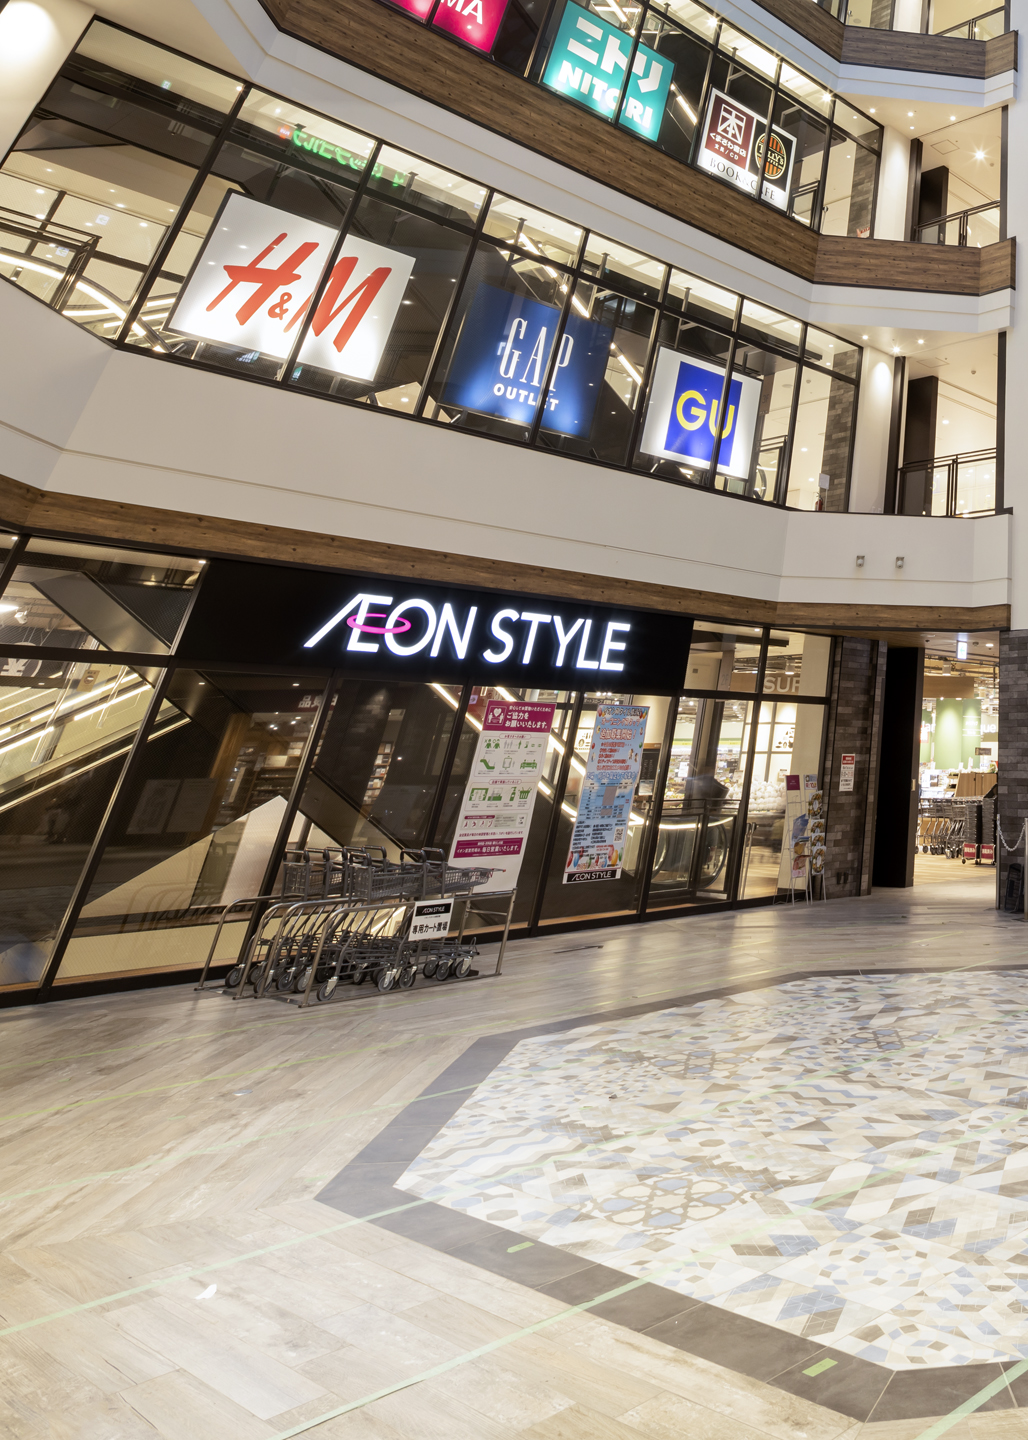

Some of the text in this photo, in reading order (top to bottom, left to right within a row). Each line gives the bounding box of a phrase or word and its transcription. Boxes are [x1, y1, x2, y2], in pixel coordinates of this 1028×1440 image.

[566, 16, 664, 94] ニトリ
[557, 60, 654, 129] NITORI
[758, 142, 785, 166] TLLY'S
[206, 232, 392, 353] H&M
[499, 317, 574, 392] GAP
[493, 383, 559, 411] OUTLT
[676, 390, 735, 439] GU
[483, 608, 631, 671] STYLE
[505, 720, 547, 729] お願いいたします。
[506, 711, 529, 720] ご協力を
[591, 870, 612, 879] STYLE
[412, 921, 449, 934] 専用カート置場
